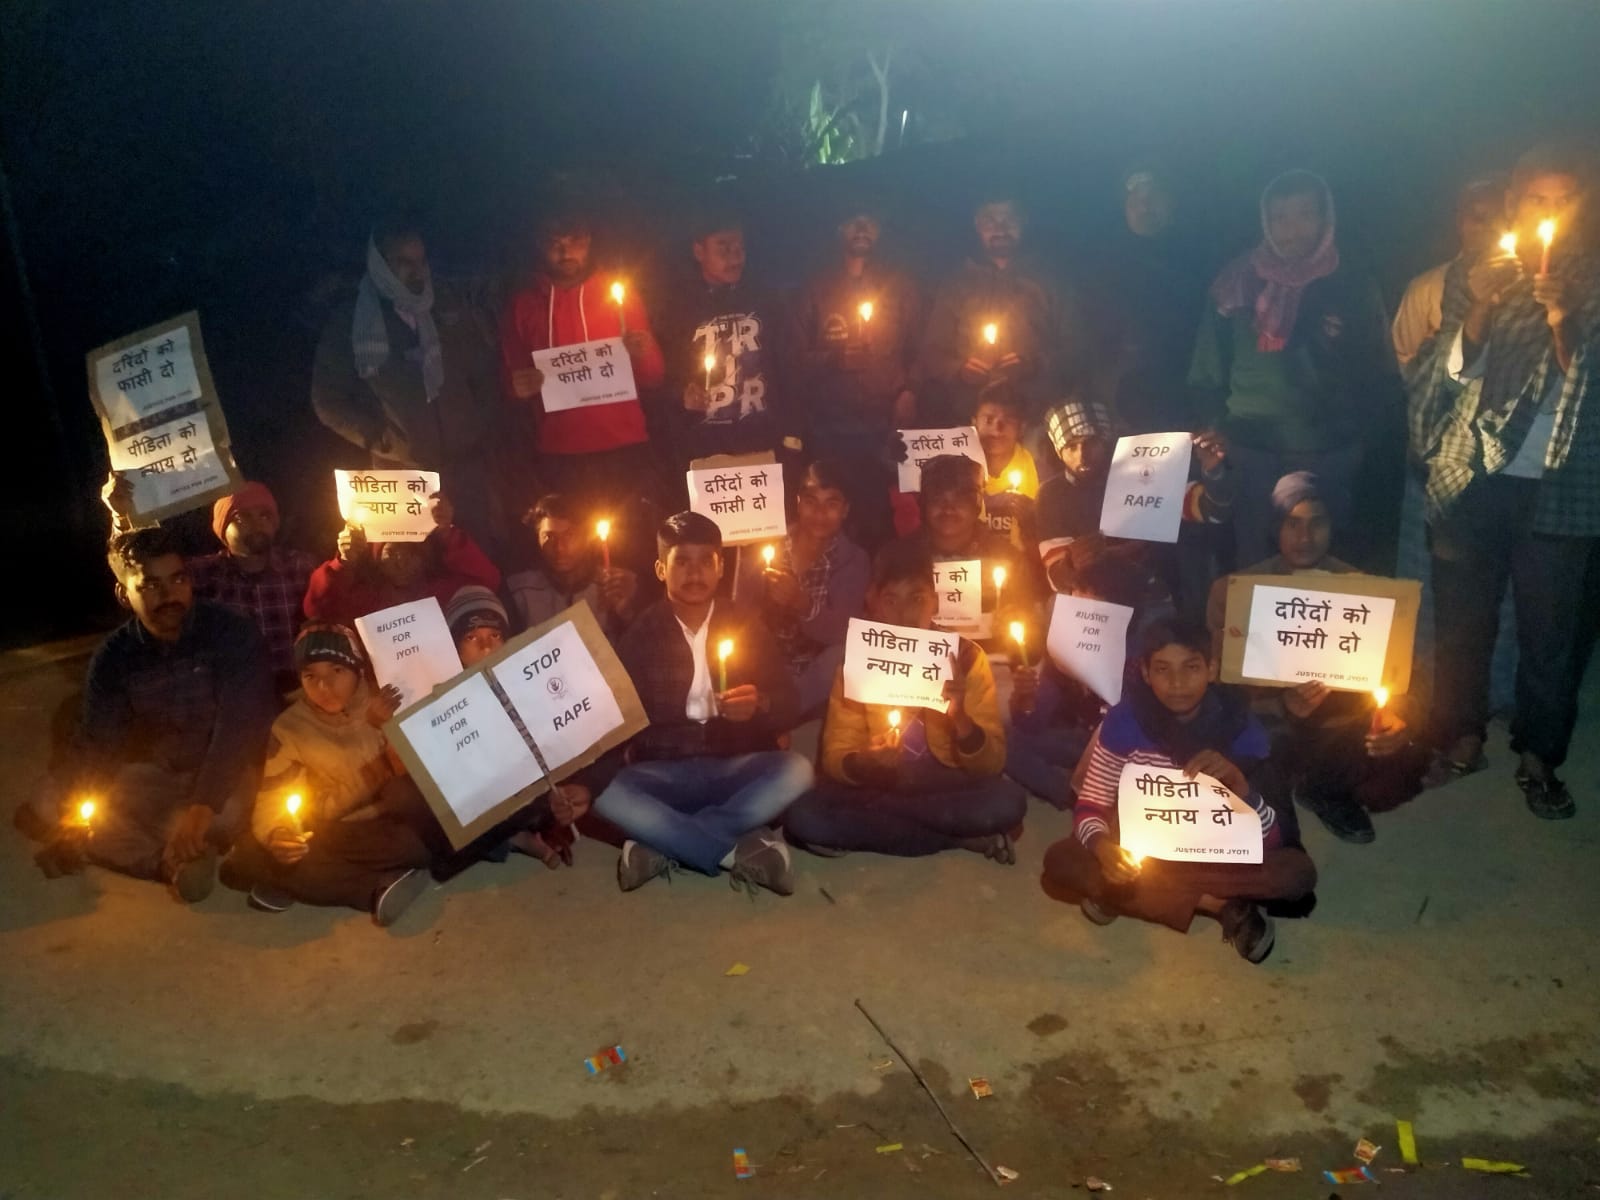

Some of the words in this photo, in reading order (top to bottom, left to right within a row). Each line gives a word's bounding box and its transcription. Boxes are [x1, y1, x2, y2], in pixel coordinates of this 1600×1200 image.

[550, 348, 588, 368] दरिंदों
[595, 343, 613, 358] को
[160, 360, 175, 378] दो
[599, 361, 614, 378] दो
[178, 421, 197, 440] को
[910, 434, 944, 452] दरिंदों
[952, 432, 969, 447] को
[183, 446, 198, 464] दो
[1131, 446, 1170, 458] STOP
[407, 476, 428, 493] को
[704, 472, 743, 494] दरिंदों
[750, 471, 768, 488] को
[406, 498, 422, 516] दो
[710, 495, 745, 514] फांसी
[752, 493, 767, 510] दो
[1123, 494, 1164, 508] RAPE
[948, 567, 968, 583] को
[946, 588, 963, 603] दो
[1275, 597, 1332, 622] दरिंदों
[1343, 604, 1371, 625] को
[377, 614, 417, 633] #JUSTICE
[1082, 626, 1100, 636] FOR
[392, 631, 412, 643] FOR
[861, 628, 919, 653] पीडिता
[928, 638, 951, 658] को
[1277, 625, 1328, 650] फांसी
[1338, 632, 1362, 654] दो
[396, 645, 419, 660] JYOTI
[1076, 641, 1101, 653] JYOTI
[522, 647, 562, 681] STOP
[866, 657, 913, 678] न्याय
[921, 663, 941, 681] दो
[1295, 671, 1328, 679] JUSTICE
[430, 697, 470, 728] #JUSTICE
[552, 696, 593, 732] RAPE
[449, 717, 468, 735] FOR
[455, 729, 480, 752] JYOTI
[1135, 773, 1200, 798] पीडिता
[1210, 785, 1231, 798] क
[1144, 808, 1199, 825] न्याय
[1211, 804, 1235, 826] दो
